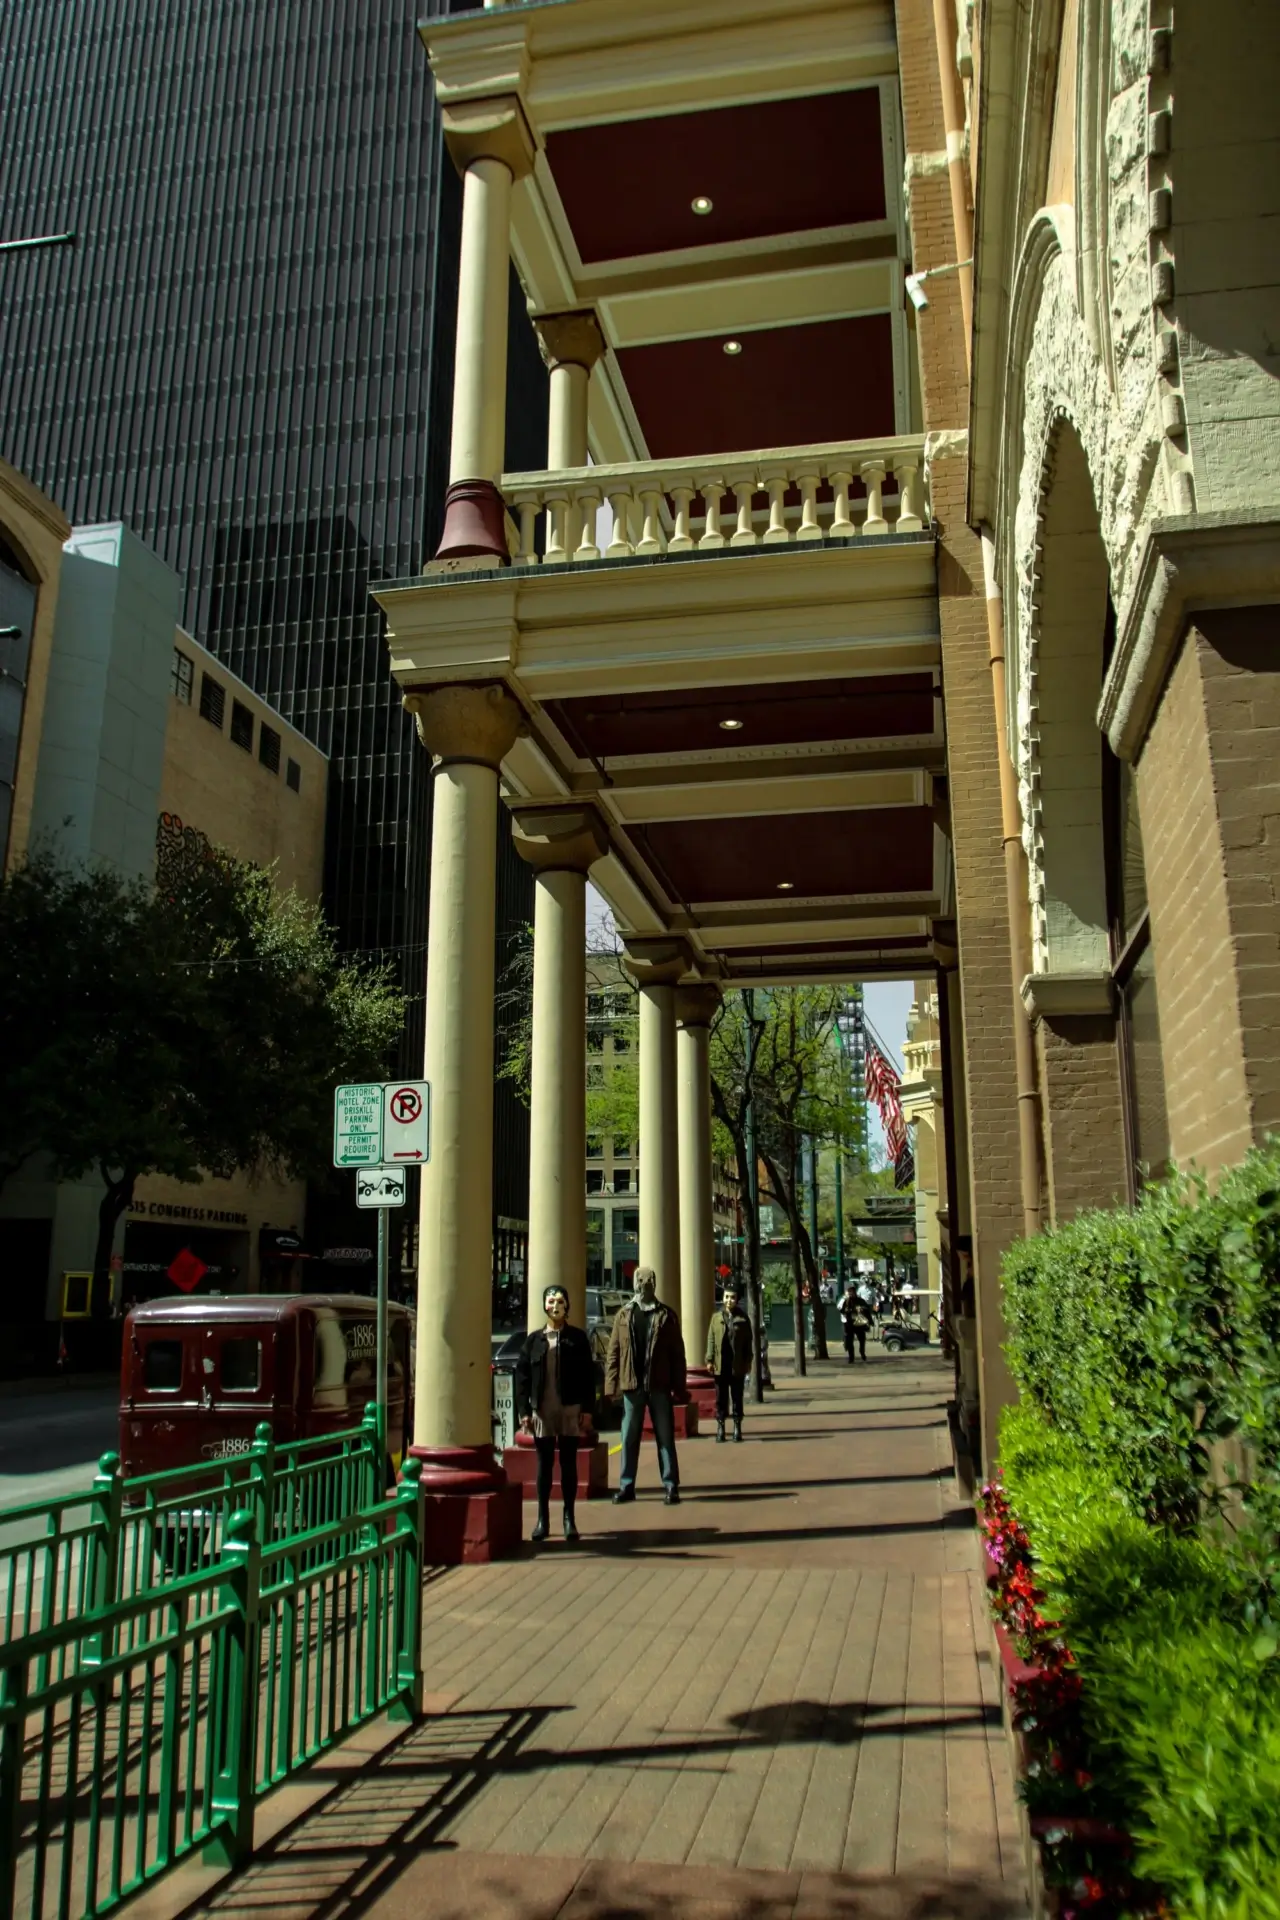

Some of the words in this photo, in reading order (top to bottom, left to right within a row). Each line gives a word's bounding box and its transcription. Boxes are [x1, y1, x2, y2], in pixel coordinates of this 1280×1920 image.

[344, 1088, 375, 1097] HISTORIC
[339, 1098, 359, 1106] HOTEL
[362, 1096, 380, 1105] ZONE
[344, 1105, 374, 1115] DRISKILL
[344, 1114, 373, 1124] PARKING
[350, 1124, 368, 1132] ONLY
[348, 1136, 372, 1145] PERMIT
[344, 1144, 377, 1154] REQUIRED
[149, 1203, 205, 1221] CONGRESS
[207, 1209, 248, 1225] PARKING
[353, 1324, 375, 1348] 1886
[496, 1399, 512, 1409] NO
[221, 1438, 250, 1453] 1886
